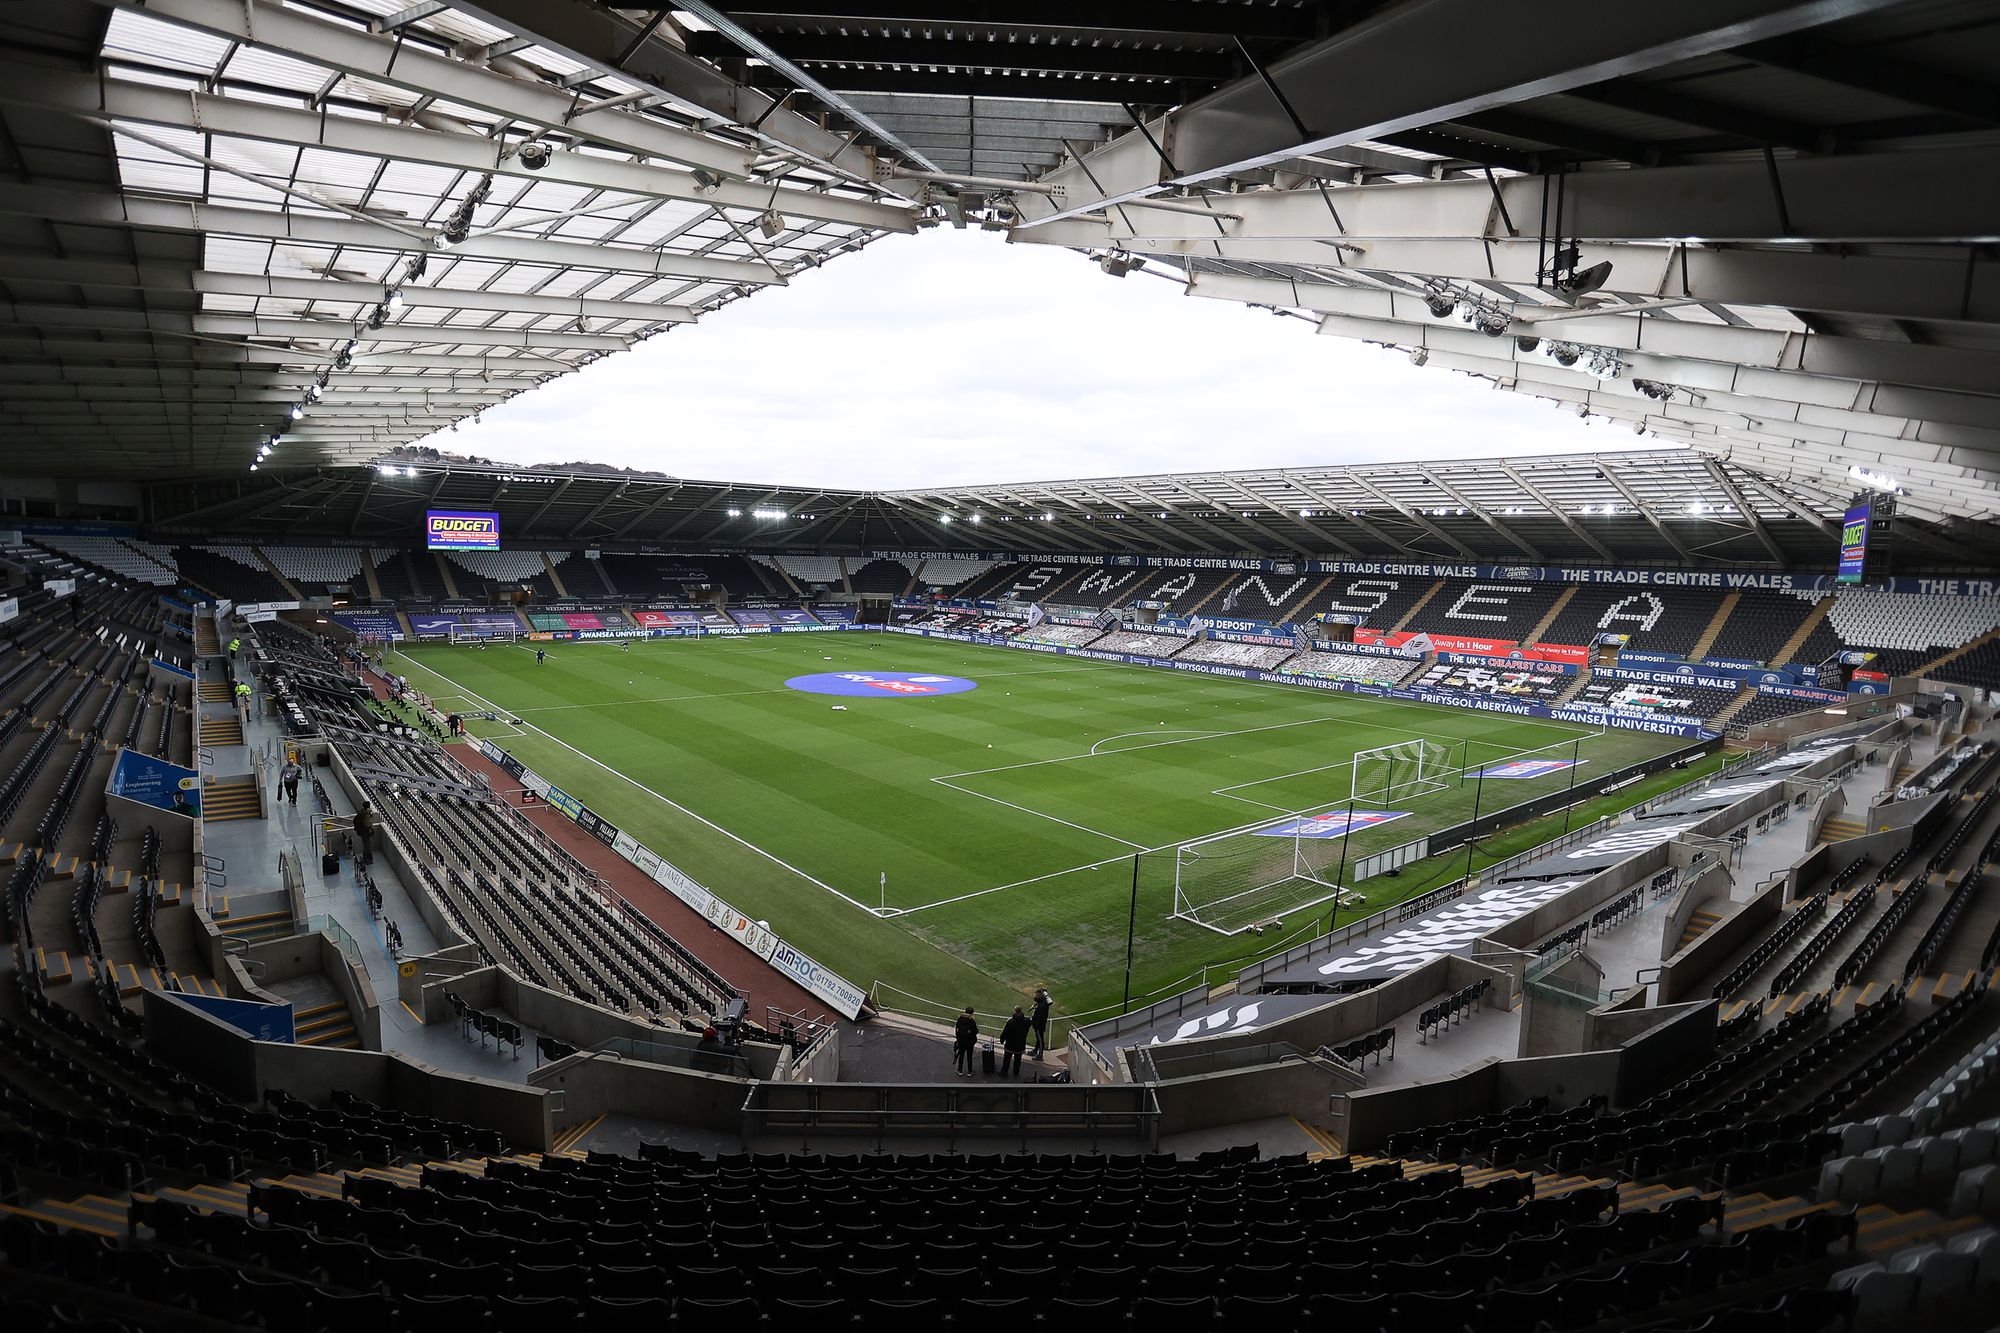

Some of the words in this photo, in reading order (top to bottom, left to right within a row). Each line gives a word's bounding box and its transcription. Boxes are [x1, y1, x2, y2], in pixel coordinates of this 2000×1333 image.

[432, 519, 491, 532] BUDGET
[890, 551, 918, 559] TRADE
[920, 552, 952, 560] CENTRE
[1018, 554, 1029, 562] THE
[1030, 554, 1052, 563] TRADE
[1053, 555, 1078, 564] CENTRE
[1080, 556, 1104, 564] WALES
[1147, 557, 1162, 566] THE
[1164, 558, 1191, 568] TRADE
[1193, 559, 1227, 568] CENTRE
[1230, 560, 1261, 570] WALES
[1320, 562, 1340, 572] THE
[1341, 562, 1380, 574] TRADE
[1384, 564, 1430, 576] CENTRE
[1432, 566, 1477, 578] WALES
[1561, 569, 1590, 582] THE
[1594, 570, 1648, 584] TRADE
[1653, 571, 1722, 586] CENTRE
[1726, 574, 1792, 588] WALES
[1918, 579, 1959, 595] THE
[616, 630, 654, 638] UNIVERSITY
[1122, 622, 1133, 630] THE
[1134, 624, 1152, 632] TRADE
[1154, 625, 1175, 634] CENTRE
[1006, 640, 1032, 650] PRIFYSGOL
[1032, 644, 1056, 653] ABERTAWE
[1216, 632, 1226, 640] THE
[1242, 635, 1273, 644] CHEAPEST
[1274, 637, 1294, 646] CARS
[1434, 639, 1456, 650] Away
[1456, 640, 1464, 648] In
[1472, 642, 1493, 650] Hour
[1066, 648, 1092, 658] SWANSEA
[1092, 651, 1124, 662] UNIVERSITY
[1332, 642, 1358, 652] TRADE
[1359, 644, 1390, 654] CENTRE
[1392, 647, 1421, 658] WAS
[1449, 654, 1464, 664] THE
[1466, 656, 1486, 665] UK'S
[1488, 658, 1534, 670] CHEAPEST
[1536, 663, 1564, 674] CARS
[1634, 655, 1666, 663] DEPOSIT!
[1174, 662, 1210, 673] PRIFYSGOL
[1210, 666, 1246, 678] ABERTAWE
[1260, 672, 1296, 685] SWANSEA
[1298, 678, 1344, 690] UNIVERSITY
[1594, 668, 1614, 677] THE
[1616, 670, 1650, 680] TRADE
[1652, 673, 1694, 684] CENTRE
[1698, 678, 1736, 689] WALES
[1760, 685, 1774, 693] THE
[1774, 686, 1790, 695] UK'S
[1791, 688, 1826, 700] CHEAPEST
[1828, 693, 1846, 702] CARS
[1421, 694, 1472, 708] PRIFYSGOL
[1475, 700, 1530, 716] ABERTAWE
[1562, 702, 1588, 712] Joma
[1589, 706, 1614, 715] Joma
[1616, 708, 1642, 719] Joma
[1644, 712, 1672, 722] Joma
[1672, 716, 1702, 726] Joma
[1550, 710, 1608, 724] SWANSEA
[1611, 717, 1686, 736] UNIVERSITY
[126, 780, 162, 788] Engineering
[550, 787, 565, 802] HAPPY
[565, 796, 582, 814] HOME
[582, 810, 597, 826] VILLAGE
[600, 822, 616, 839] VILLAGE
[663, 868, 685, 888] JANELA
[776, 946, 818, 981] AMROC
[816, 974, 836, 991] 01792
[836, 986, 861, 1007] 700820
